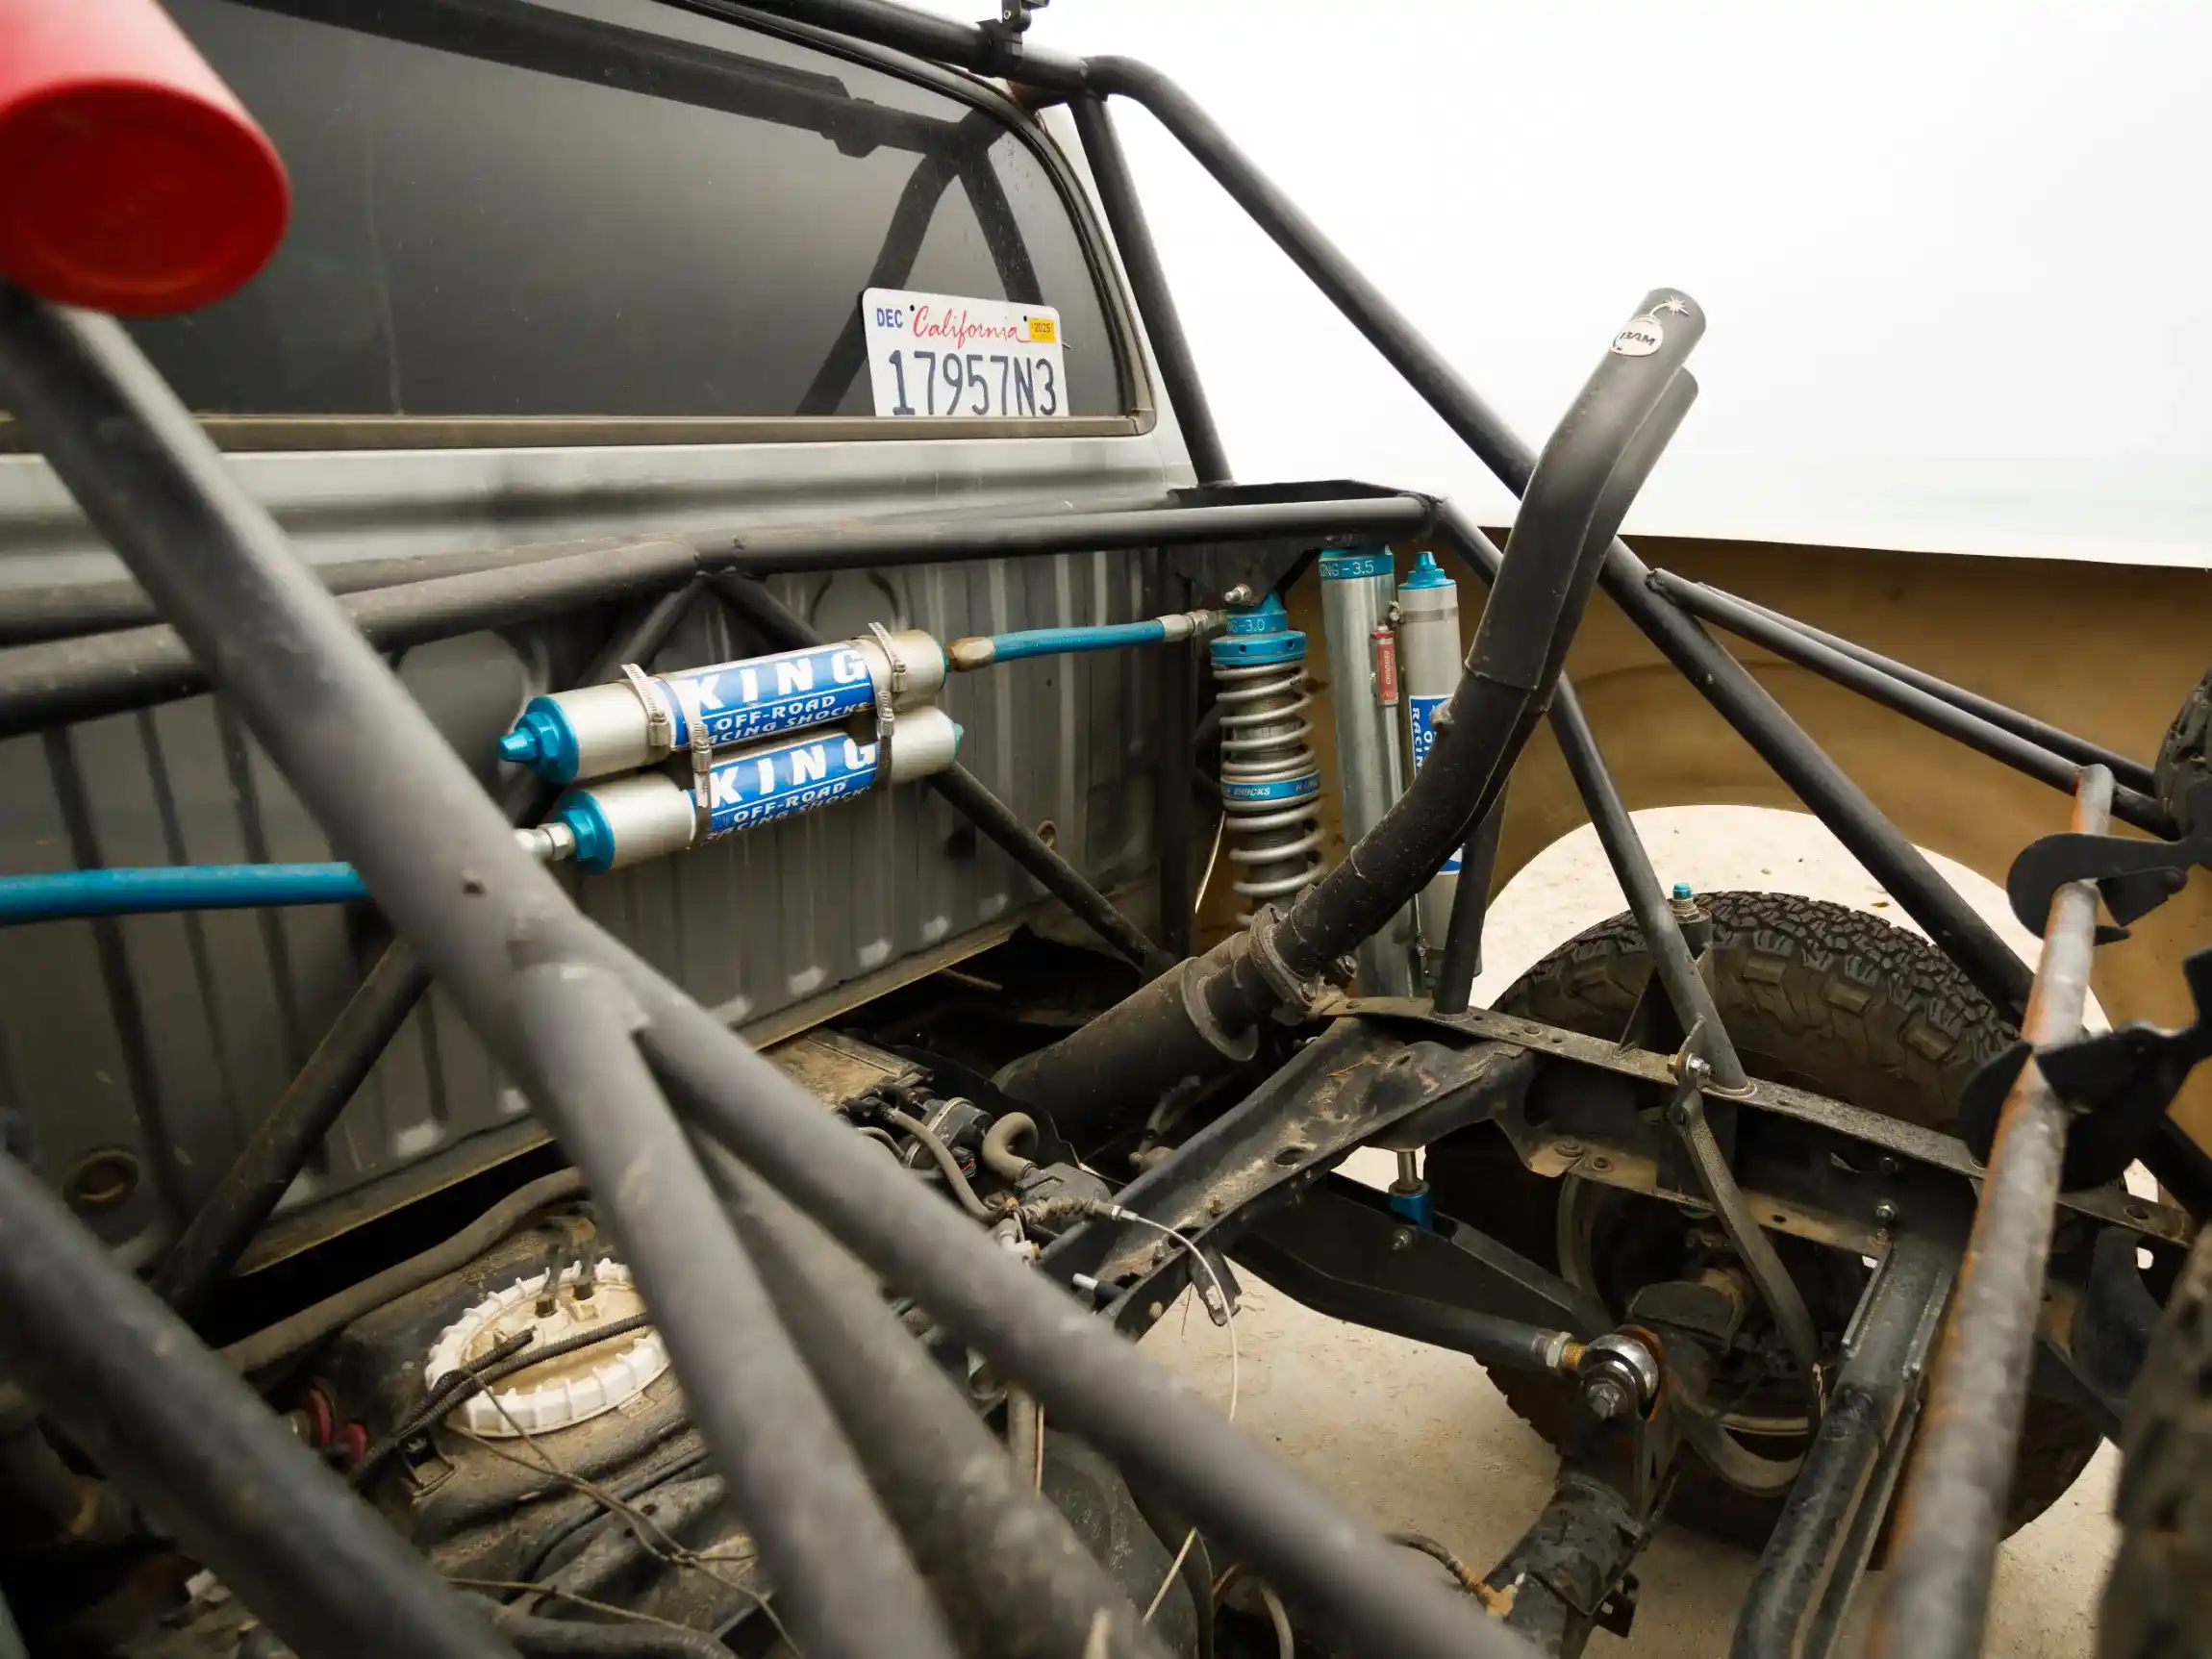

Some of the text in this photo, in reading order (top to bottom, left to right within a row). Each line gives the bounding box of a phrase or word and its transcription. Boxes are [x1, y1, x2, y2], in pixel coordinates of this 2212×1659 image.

[876, 305, 1051, 349] DEC California 2025
[1620, 331, 1656, 346] BAM
[889, 349, 1057, 415] 17957N3
[1352, 560, 1374, 575] 3.5
[679, 649, 867, 710] KING
[708, 701, 871, 746] ACING SHOCKS
[716, 694, 836, 732] OFF-ROAD
[1412, 707, 1423, 767] RACIN
[710, 738, 876, 809] KING
[733, 781, 847, 823] OFF-ROAD
